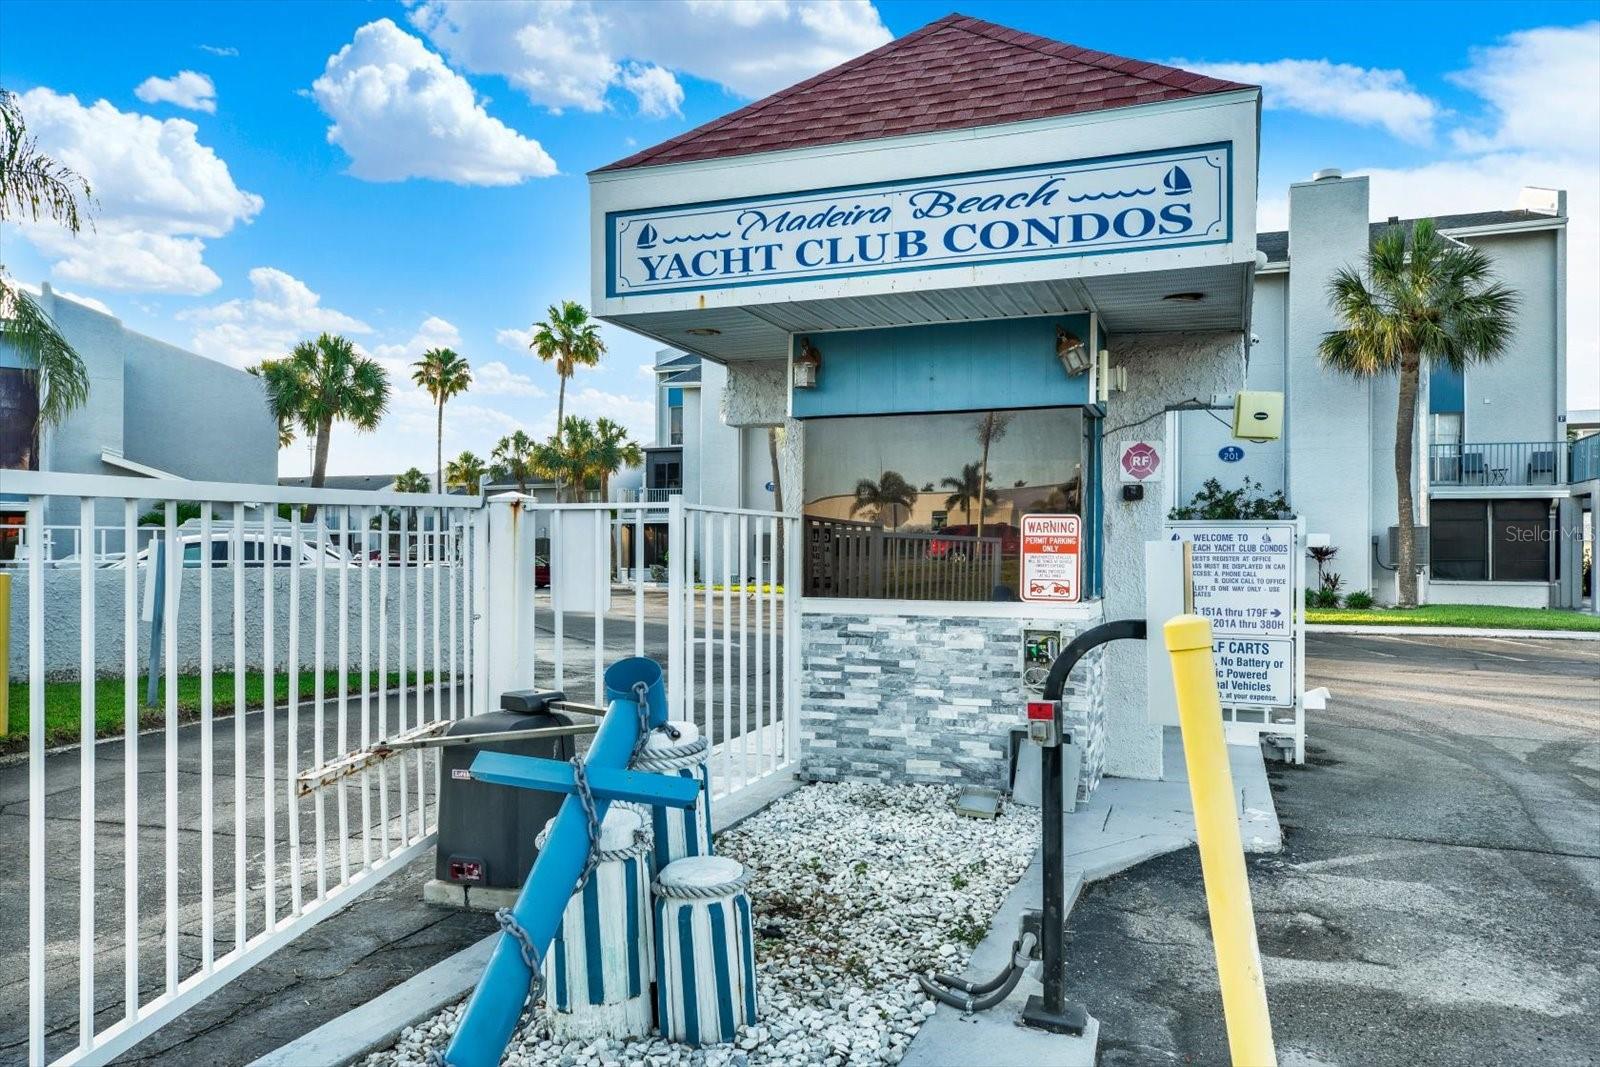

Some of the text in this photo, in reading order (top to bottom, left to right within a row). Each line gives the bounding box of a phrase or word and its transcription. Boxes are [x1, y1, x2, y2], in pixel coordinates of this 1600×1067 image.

[737, 176, 1066, 241] Madeira Beach
[637, 203, 1193, 282] YACHT CLUB CONDOS
[1132, 455, 1149, 466] RF
[1223, 452, 1239, 461] 201
[1027, 521, 1075, 534] WARNING
[1025, 537, 1077, 545] PERMIT PARKING
[1193, 533, 1249, 542] WELCOME TO
[1042, 545, 1059, 553] ONLY
[1192, 544, 1288, 553] EACH YACHT CLUB CONDOS
[1201, 607, 1223, 617] 151A
[1225, 608, 1243, 618] thru
[1246, 608, 1268, 618] 179F
[1213, 618, 1285, 630] 201A thru 380H
[1211, 641, 1270, 655] LF CARTS
[1220, 656, 1234, 667] No
[1236, 657, 1271, 670] Battery
[1273, 660, 1284, 669] or
[1226, 668, 1268, 680] Powered
[1231, 680, 1272, 692] Vehicles
[1233, 693, 1249, 701] your
